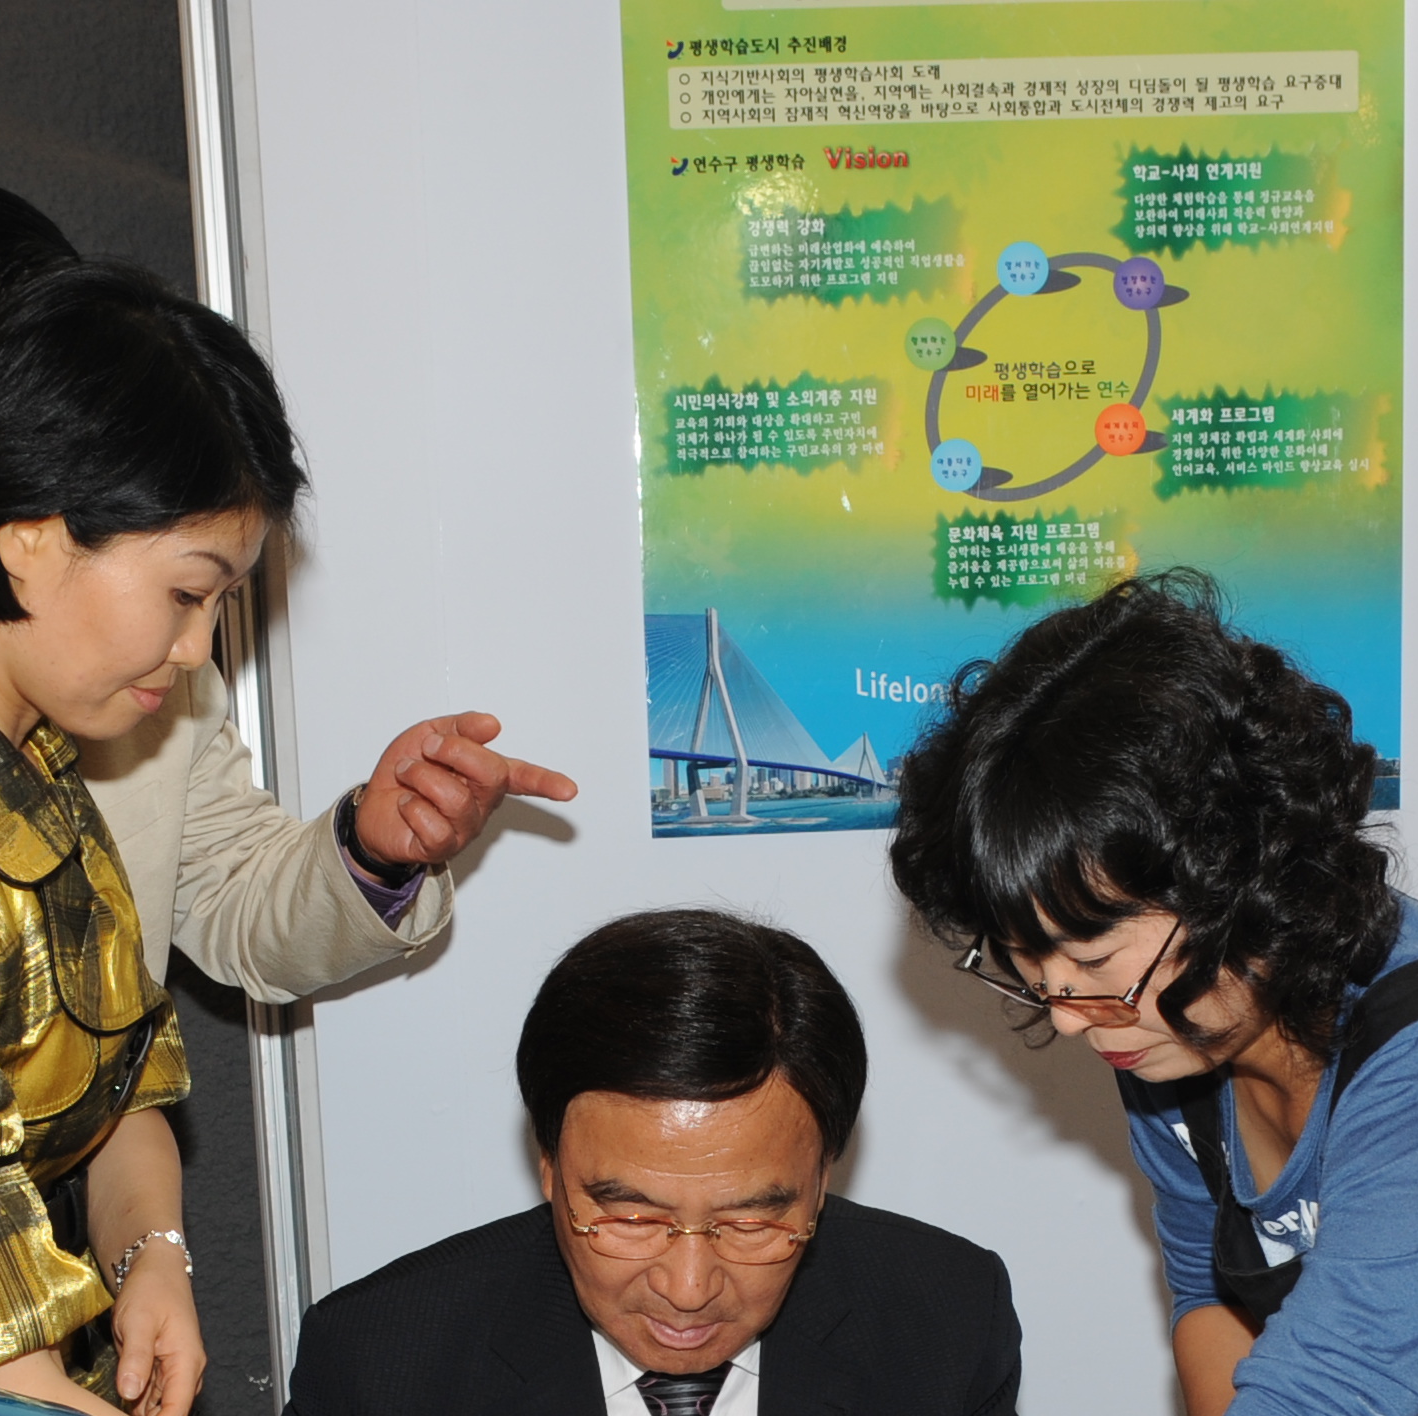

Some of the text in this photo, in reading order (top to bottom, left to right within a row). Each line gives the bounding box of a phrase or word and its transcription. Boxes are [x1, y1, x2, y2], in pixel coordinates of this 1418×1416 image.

[689, 35, 846, 57] 평생학습도시 추진배경
[701, 65, 940, 86] 지식기반사회의 평생학습사회 도래
[701, 88, 775, 105] 개인에게는
[874, 84, 931, 100] 지역에는
[941, 81, 1014, 98] 사회결속과
[1024, 80, 1066, 97] 경제적
[1076, 79, 1118, 96] 성장의
[1129, 77, 1185, 94] 디딤돌이
[1195, 77, 1208, 92] 될
[1218, 75, 1274, 95] 평생학습
[1285, 73, 1341, 91] 요구증대
[702, 94, 1283, 124] 지역사회의 잠재적 혁신역량을 바탕으로 사회통합과 도시전체의 경쟁력 제고의 요구
[693, 145, 909, 173] 연수구 평생학습 Vision
[1133, 162, 1261, 182] 학교-사회 연계지원
[748, 217, 825, 237] 경쟁력 강화
[994, 360, 1096, 380] 평생학습으로
[673, 388, 876, 411] 시민의식강화 및 소외계층 지원
[965, 380, 1130, 404] 미래를 열어가는 연수
[1171, 405, 1274, 425] 세계화 프로그램
[948, 522, 1099, 543] 문화체육 지원 프로그램
[855, 667, 955, 704] Lifelon
